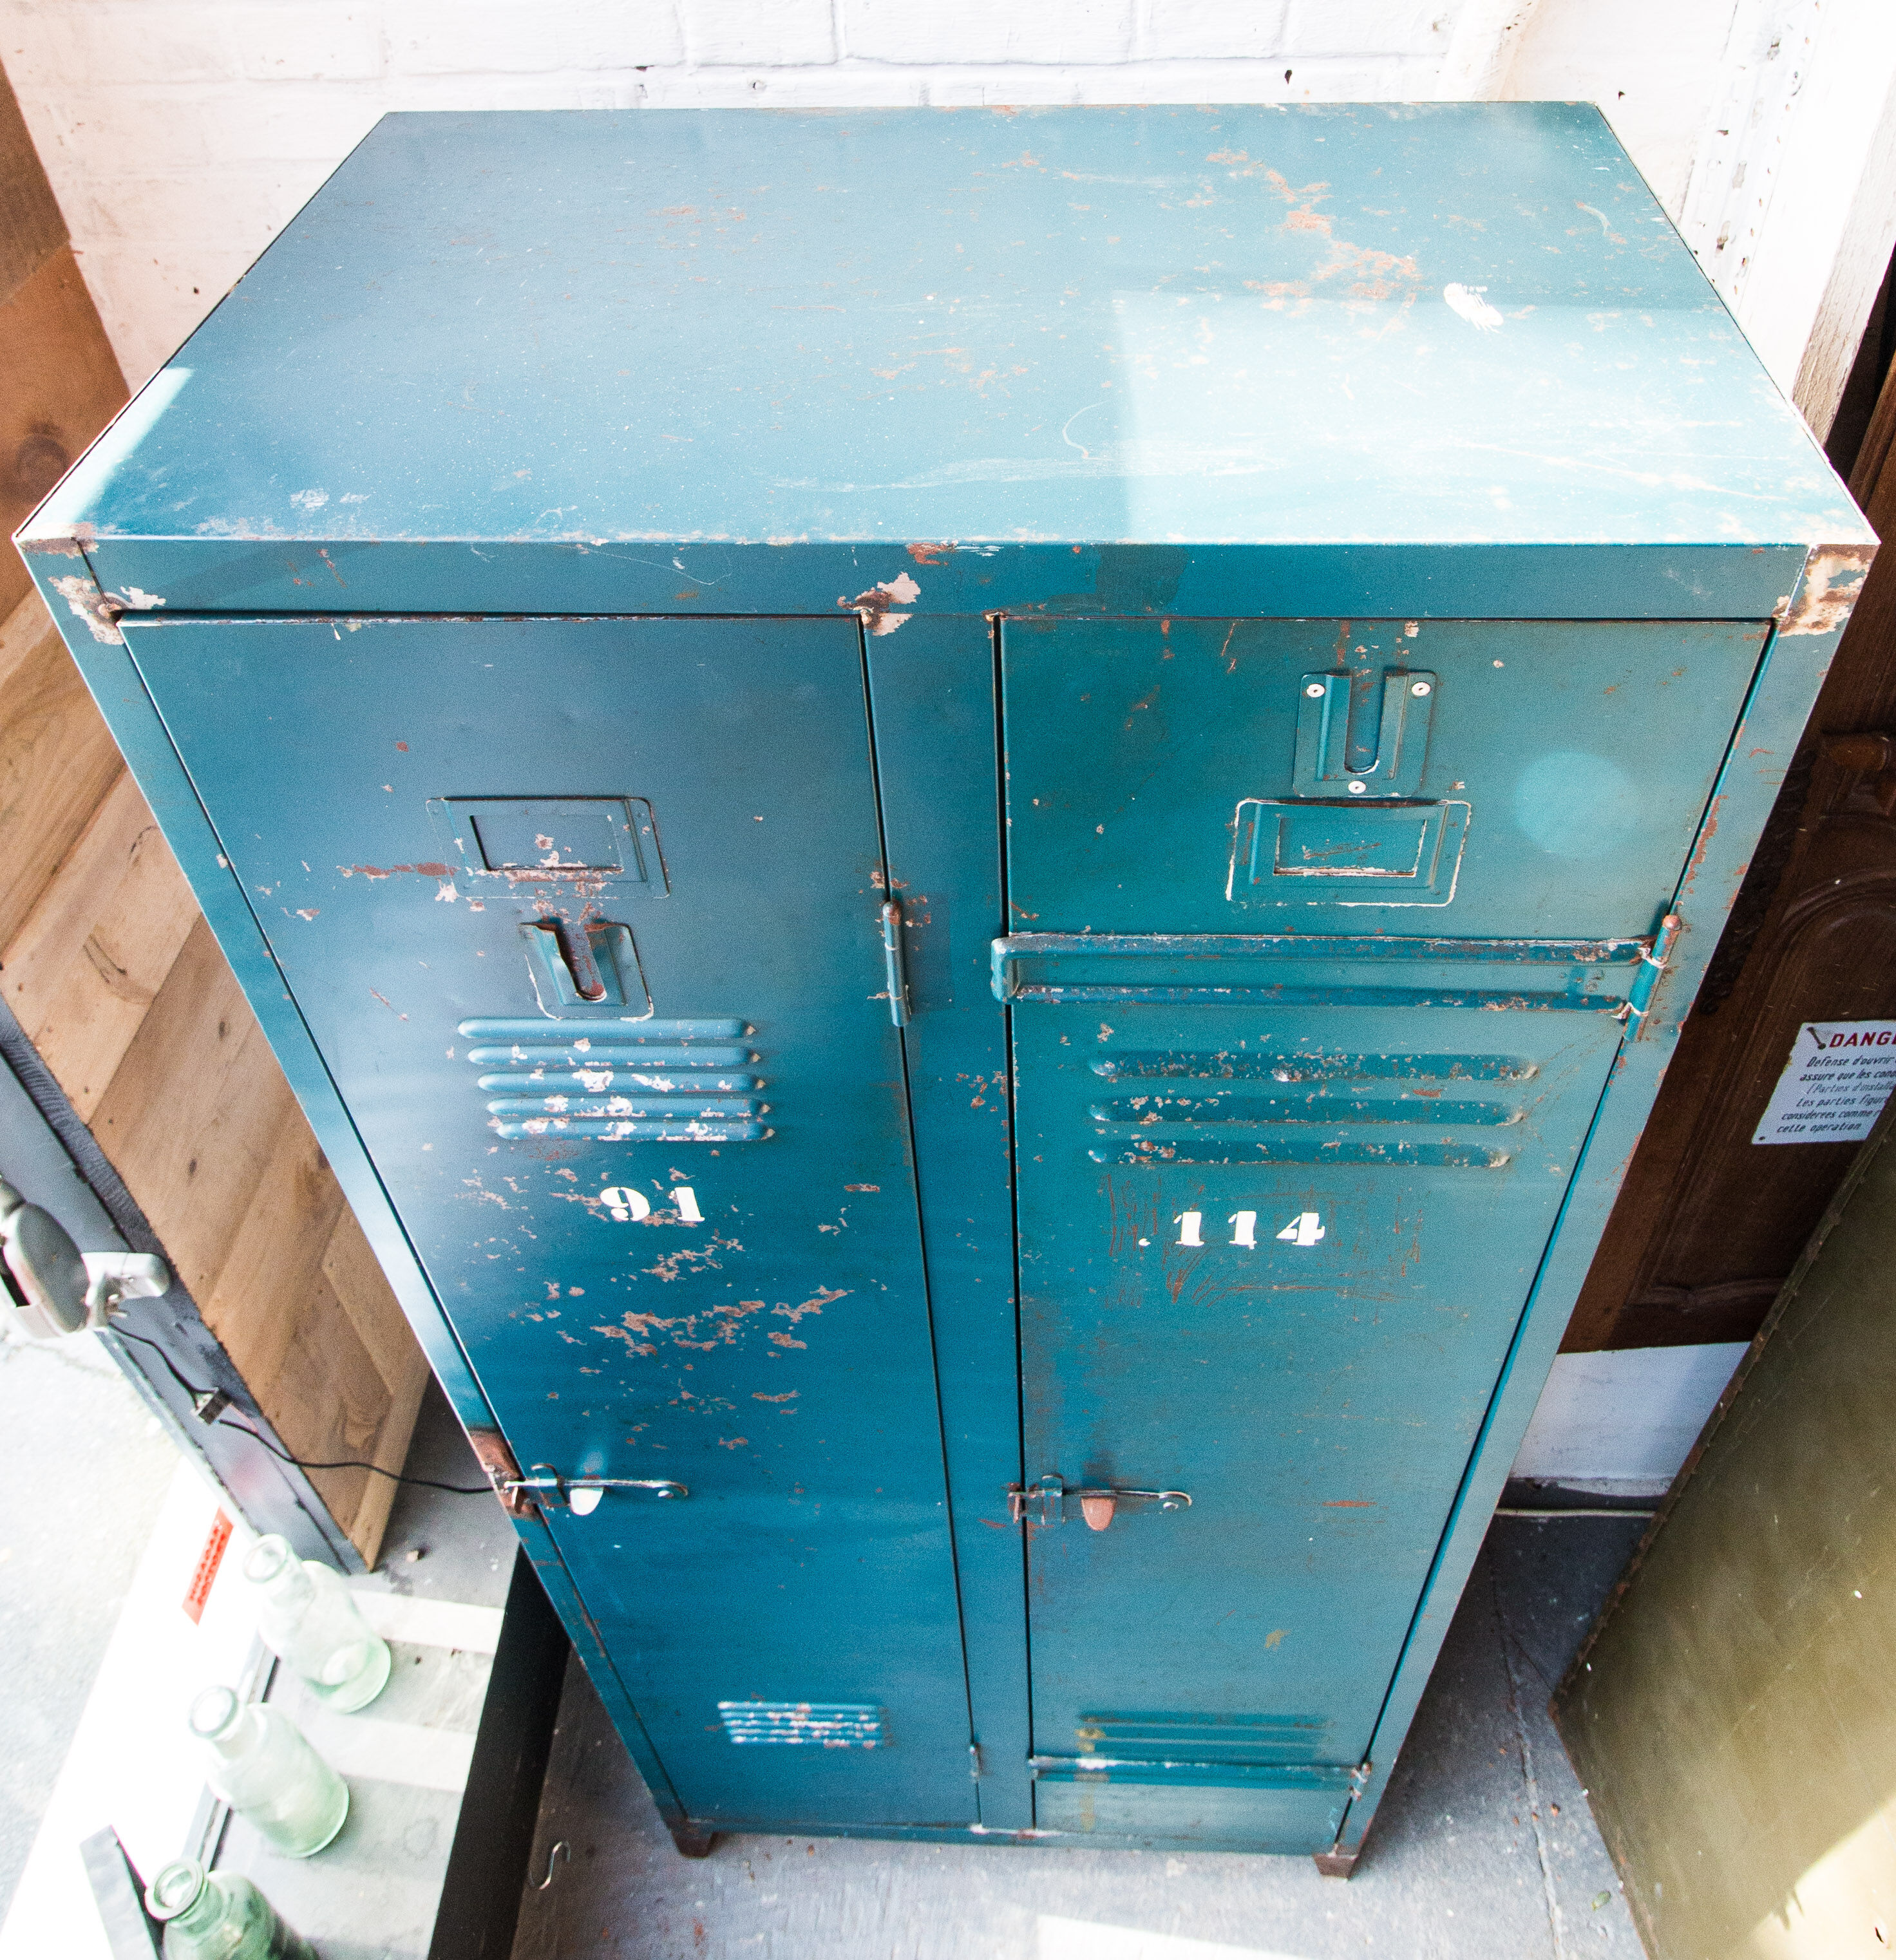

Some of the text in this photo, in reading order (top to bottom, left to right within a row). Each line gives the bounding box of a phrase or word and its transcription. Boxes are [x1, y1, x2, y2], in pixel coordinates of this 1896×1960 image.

[1799, 1073, 1835, 1082] assure
[1837, 1072, 1855, 1081] que
[1856, 1068, 1872, 1079] les
[1796, 1097, 1815, 1107] Les
[1815, 1097, 1857, 1108] parties
[1838, 1110, 1873, 1118] comme
[1777, 1124, 1806, 1133] cette
[600, 1186, 705, 1222] 91
